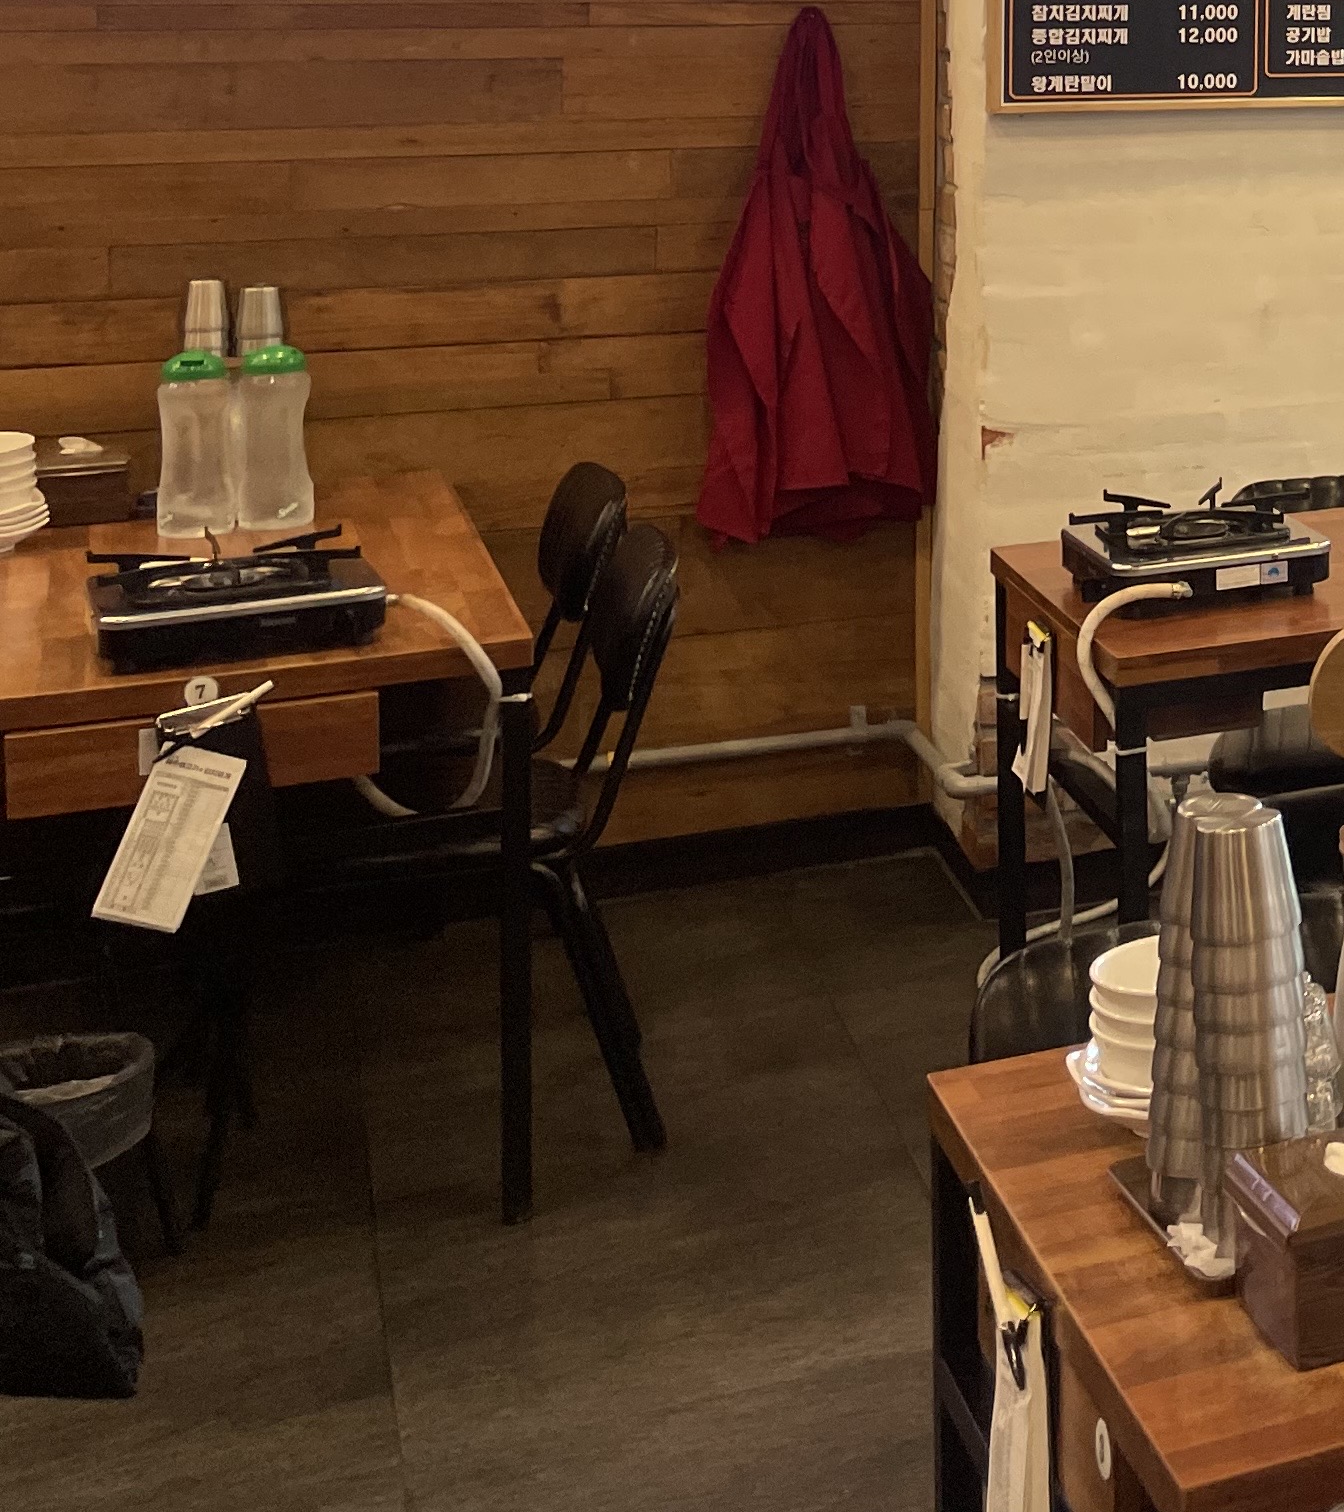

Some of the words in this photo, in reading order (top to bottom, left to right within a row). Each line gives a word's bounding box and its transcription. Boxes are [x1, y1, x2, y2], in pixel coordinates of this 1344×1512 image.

[1178, 4, 1239, 22] 11,000
[1178, 27, 1238, 45] 12,000
[1285, 26, 1332, 44] 공기밥
[1030, 48, 1090, 65] (2인이상)
[1177, 73, 1238, 91] 10,000
